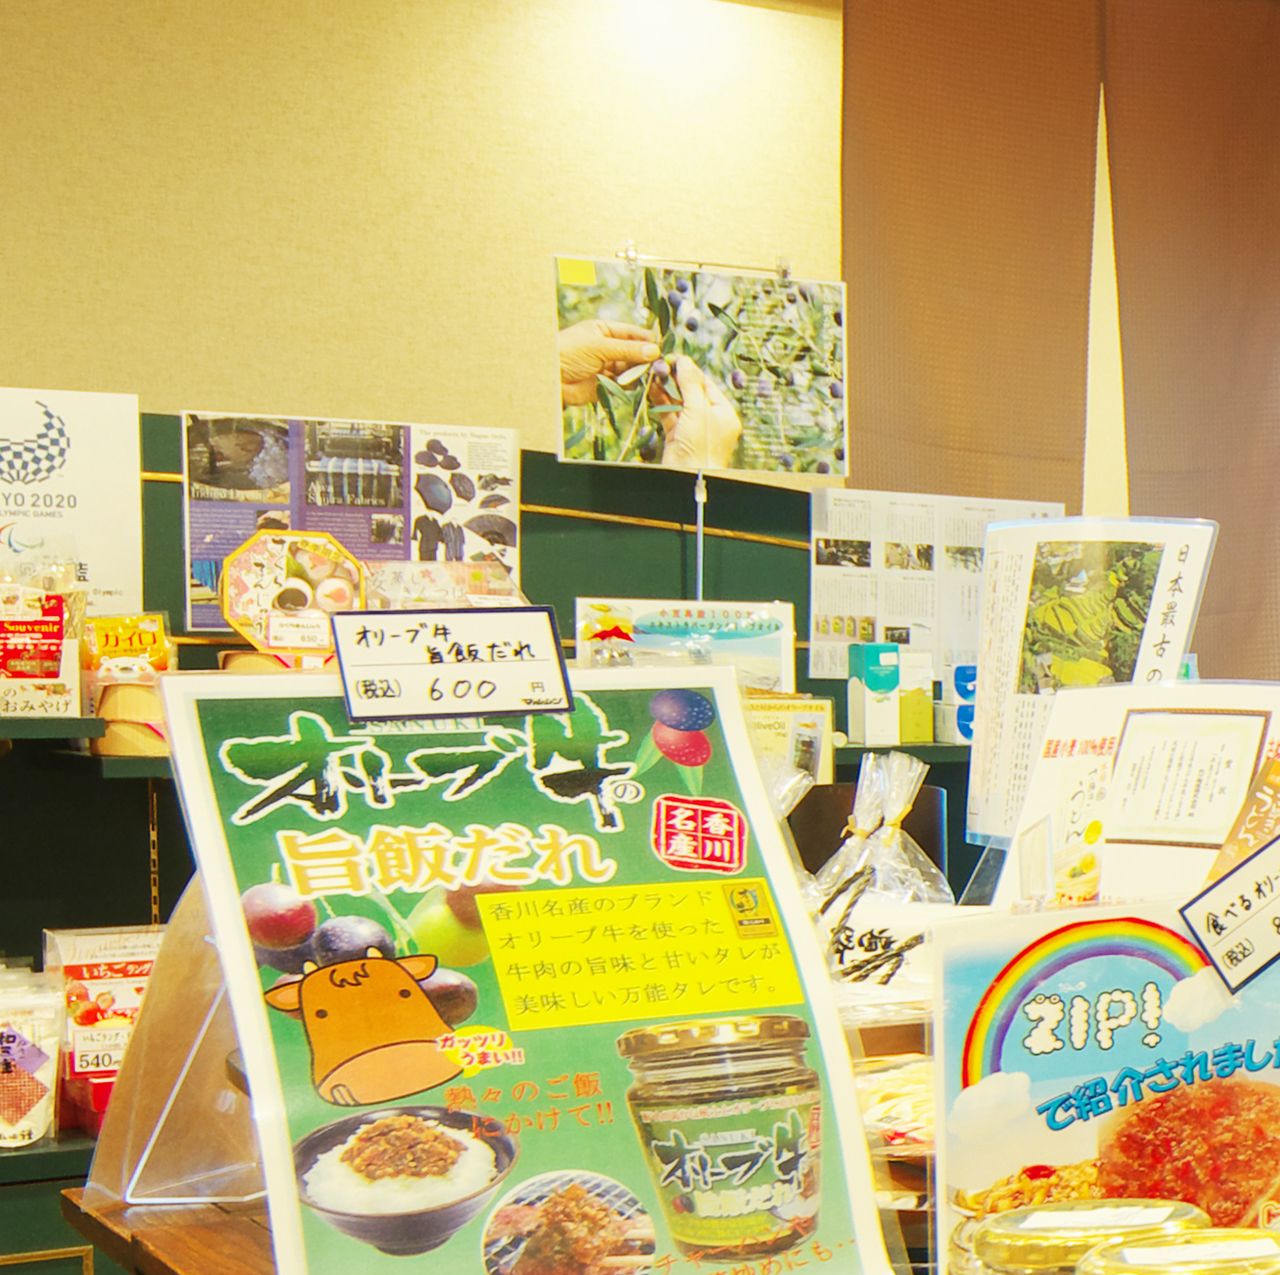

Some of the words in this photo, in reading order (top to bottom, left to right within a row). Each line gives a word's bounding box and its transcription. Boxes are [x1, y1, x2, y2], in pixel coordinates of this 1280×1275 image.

[30, 494, 78, 509] 2020
[1146, 542, 1191, 684] 日本最古の
[3, 621, 60, 634] Souvenir
[355, 622, 451, 648] オリーブ牛
[101, 633, 158, 649] カイロ
[426, 641, 536, 664] 旨飯だれ
[429, 677, 497, 701] 600
[531, 682, 545, 694] 円
[1, 698, 72, 714] おみやげ
[277, 823, 617, 899] 旨飯だれ
[488, 888, 714, 922] 香川名産のブランド
[499, 918, 727, 952] オリーブ牛を使った
[506, 941, 782, 983] 牛肉の旨味と甘いタレが
[515, 973, 778, 1016] 美味しい万能タレです。
[1021, 981, 1165, 1057] ZIP!
[434, 1030, 506, 1053] ガッツリ
[78, 1052, 113, 1070] 540
[445, 1070, 602, 1114] 熱々のご飯
